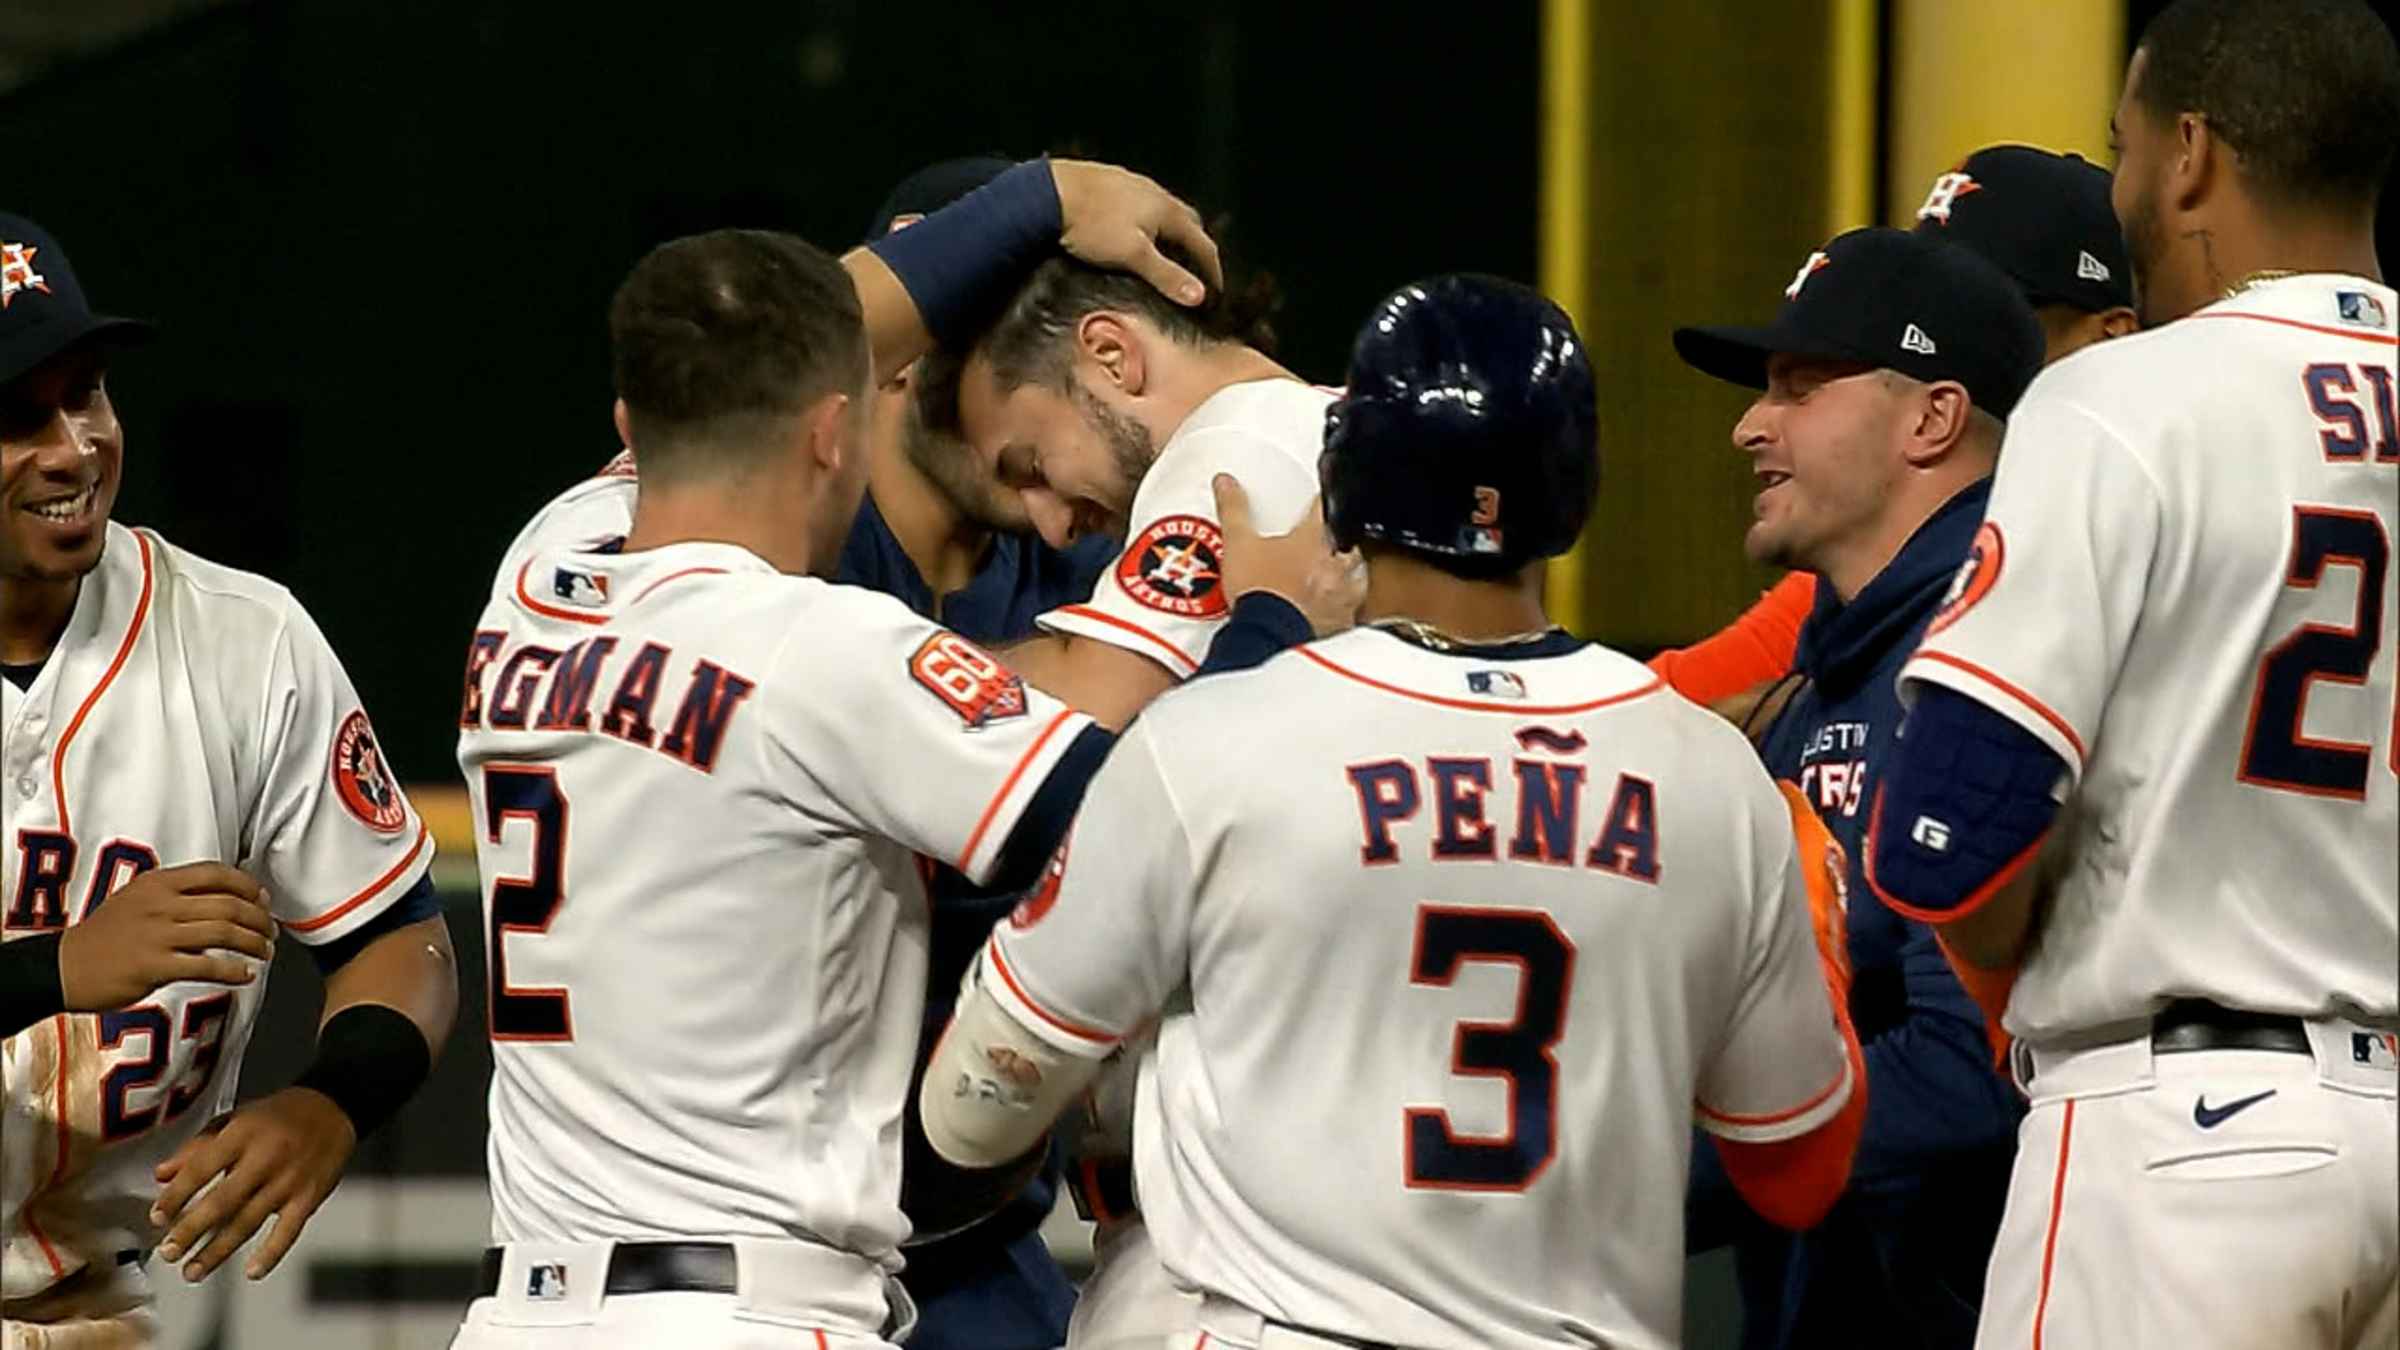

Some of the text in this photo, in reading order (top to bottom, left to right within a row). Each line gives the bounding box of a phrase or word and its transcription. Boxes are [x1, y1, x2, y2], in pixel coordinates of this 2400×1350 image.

[1471, 485, 1500, 525] 3
[1121, 575, 1204, 614] ASTROS
[919, 637, 999, 704] 60
[1345, 725, 1662, 885] PEÑA
[481, 763, 575, 1043] 2
[97, 992, 232, 1142] 23
[1403, 903, 1578, 1190] 3
